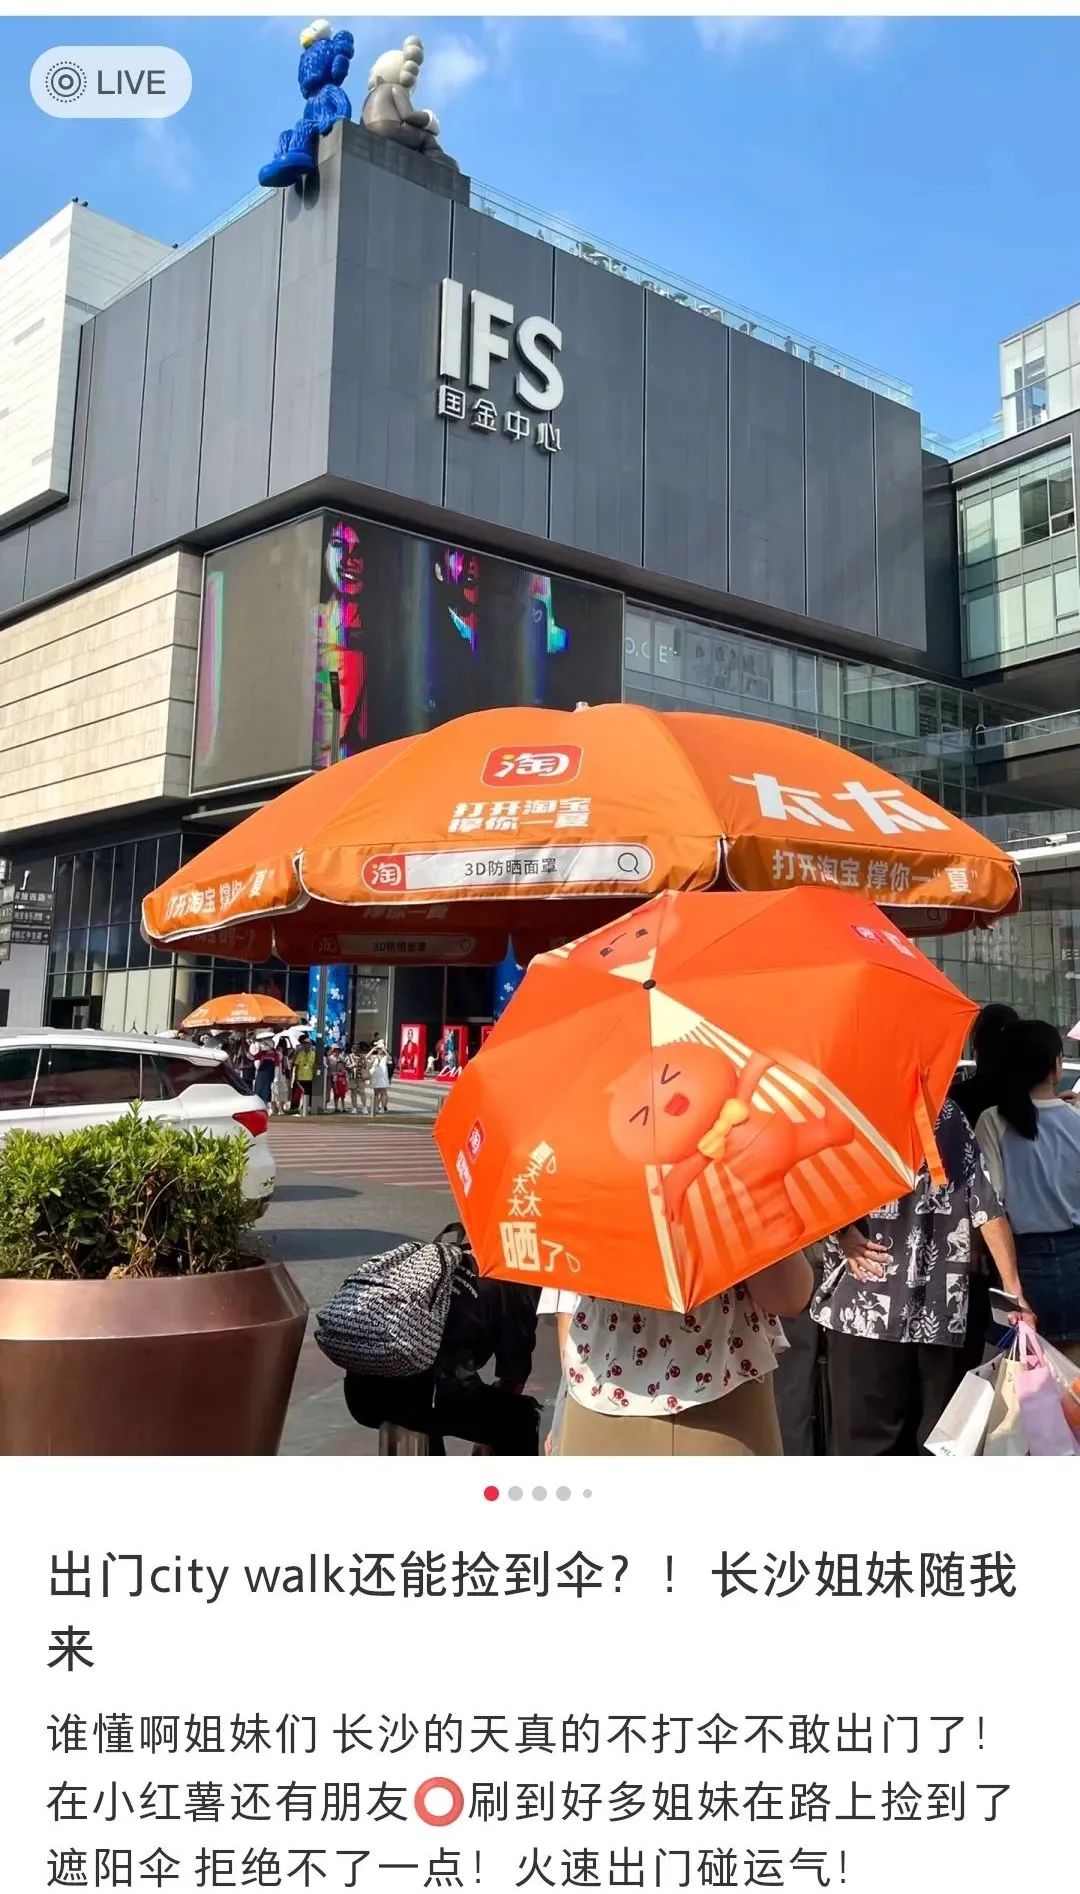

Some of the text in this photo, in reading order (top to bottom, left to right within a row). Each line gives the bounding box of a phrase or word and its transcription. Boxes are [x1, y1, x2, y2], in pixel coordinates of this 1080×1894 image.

[439, 277, 564, 412] IFS
[438, 384, 562, 452] 国金中心
[492, 752, 570, 778] 淘
[453, 797, 592, 820] 打开淘宝
[371, 857, 557, 885] 淘 3D防晒面罩
[772, 849, 861, 889] 打开淘宝
